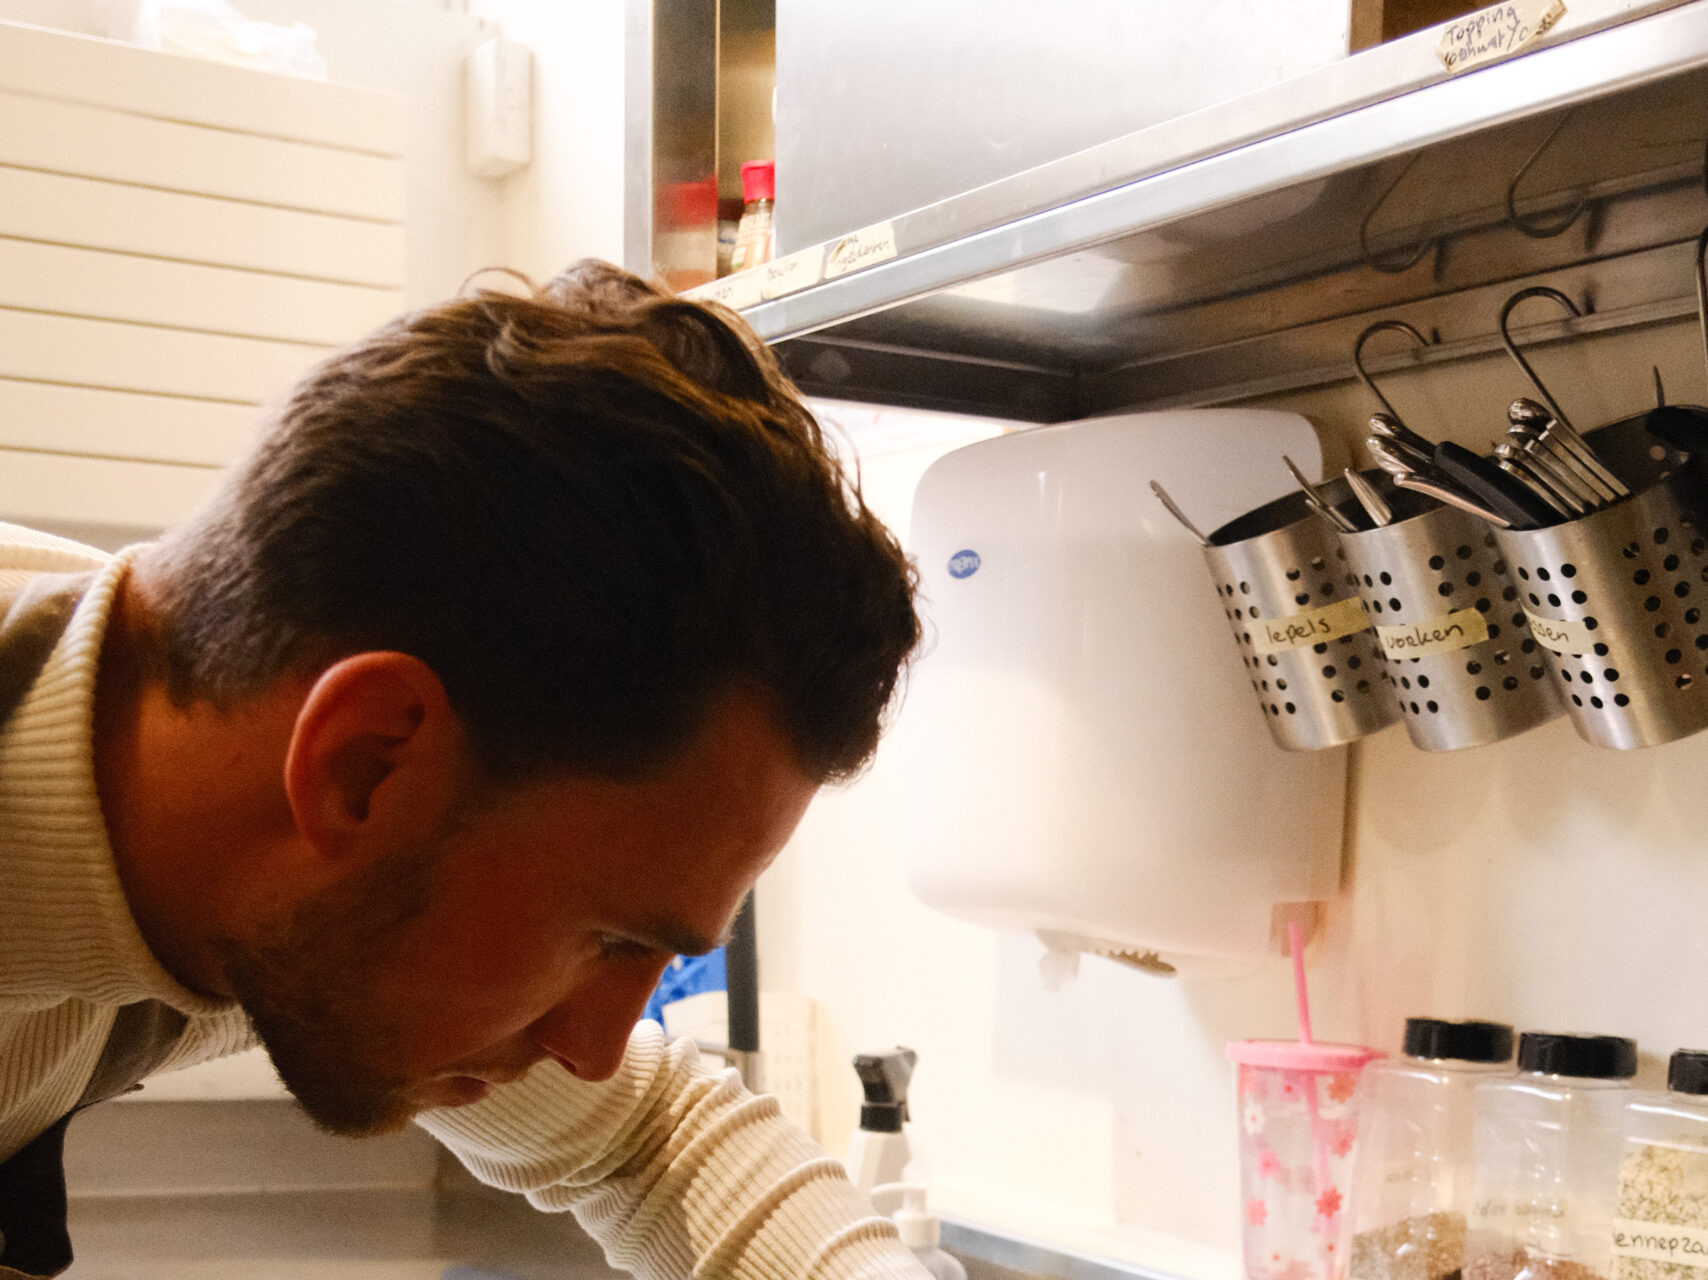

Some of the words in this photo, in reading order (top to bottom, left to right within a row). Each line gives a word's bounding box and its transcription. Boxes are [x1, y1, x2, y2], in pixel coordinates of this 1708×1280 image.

[1446, 6, 1520, 46] Topping
[1265, 618, 1331, 645] lepels
[1385, 624, 1465, 650] vorken
[1612, 1227, 1708, 1258] ennepza
